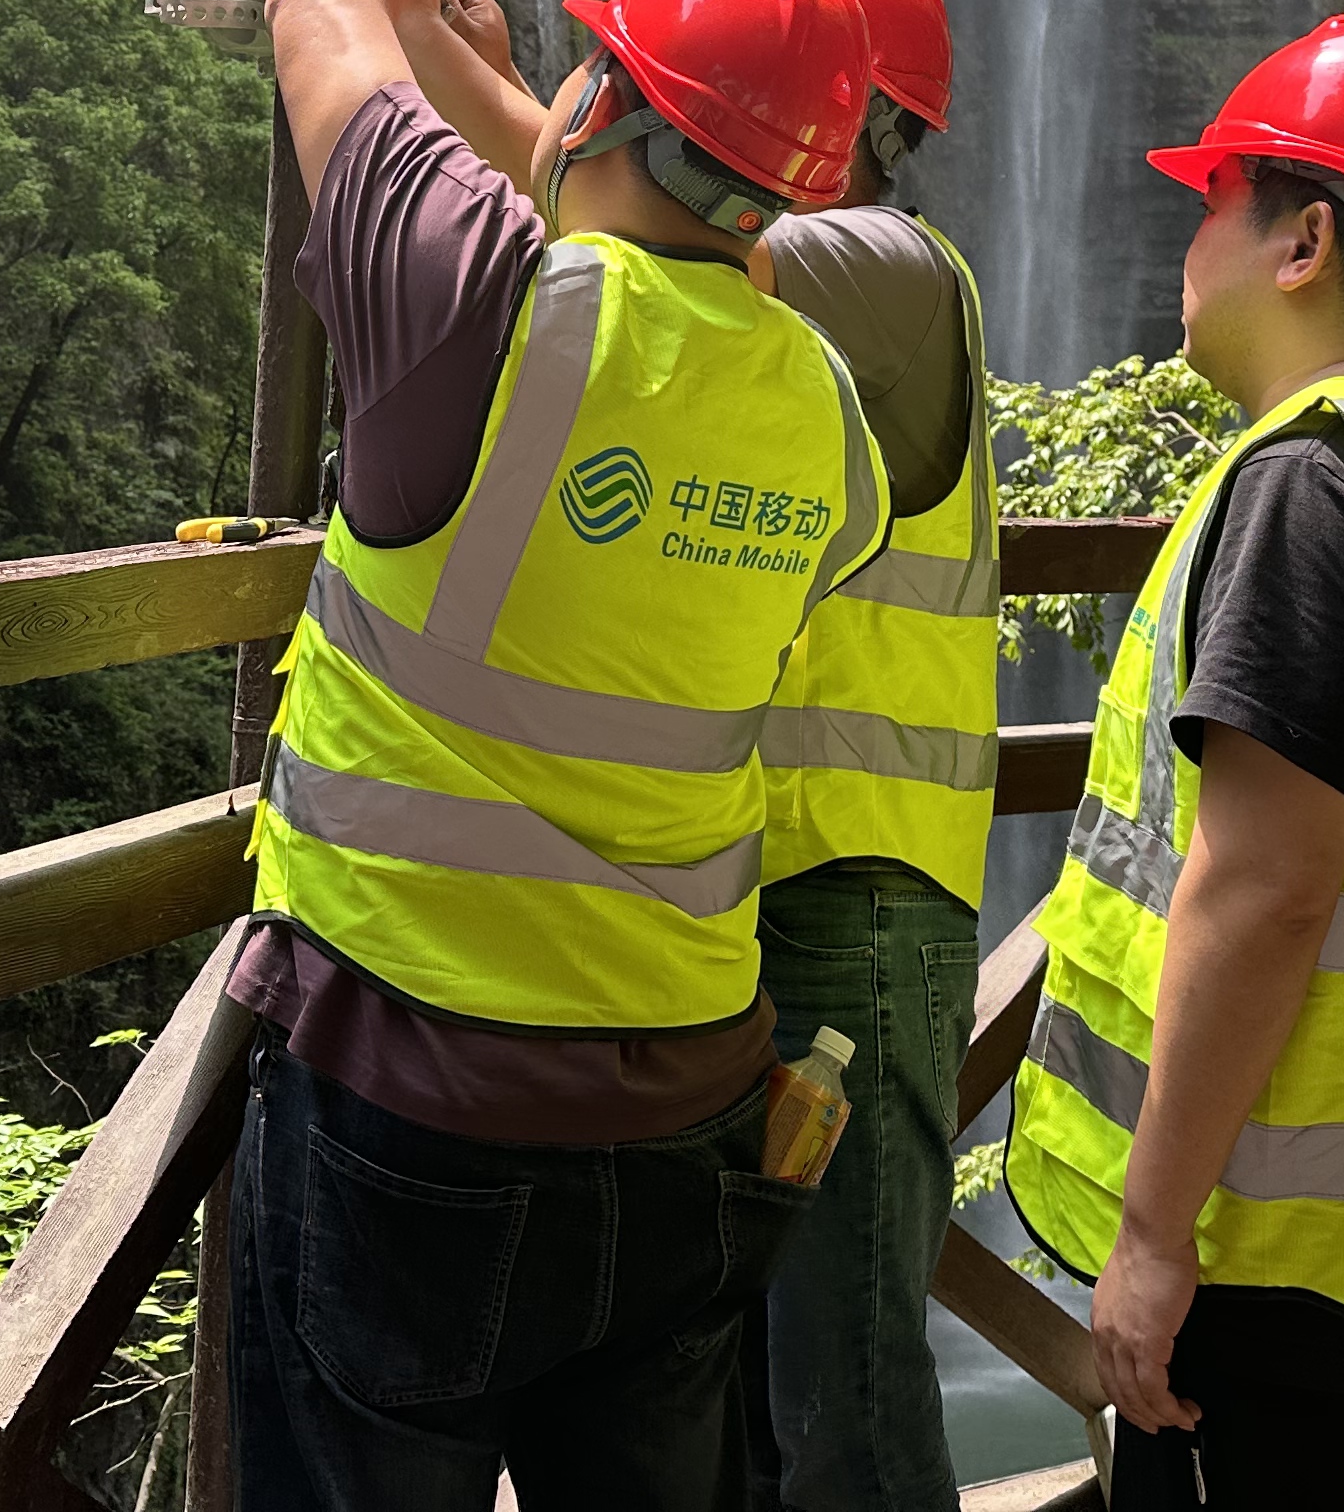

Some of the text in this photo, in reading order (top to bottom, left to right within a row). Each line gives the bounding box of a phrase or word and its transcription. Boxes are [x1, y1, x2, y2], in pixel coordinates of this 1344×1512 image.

[668, 473, 832, 542] 中国移动
[661, 531, 810, 575] China Mobile
